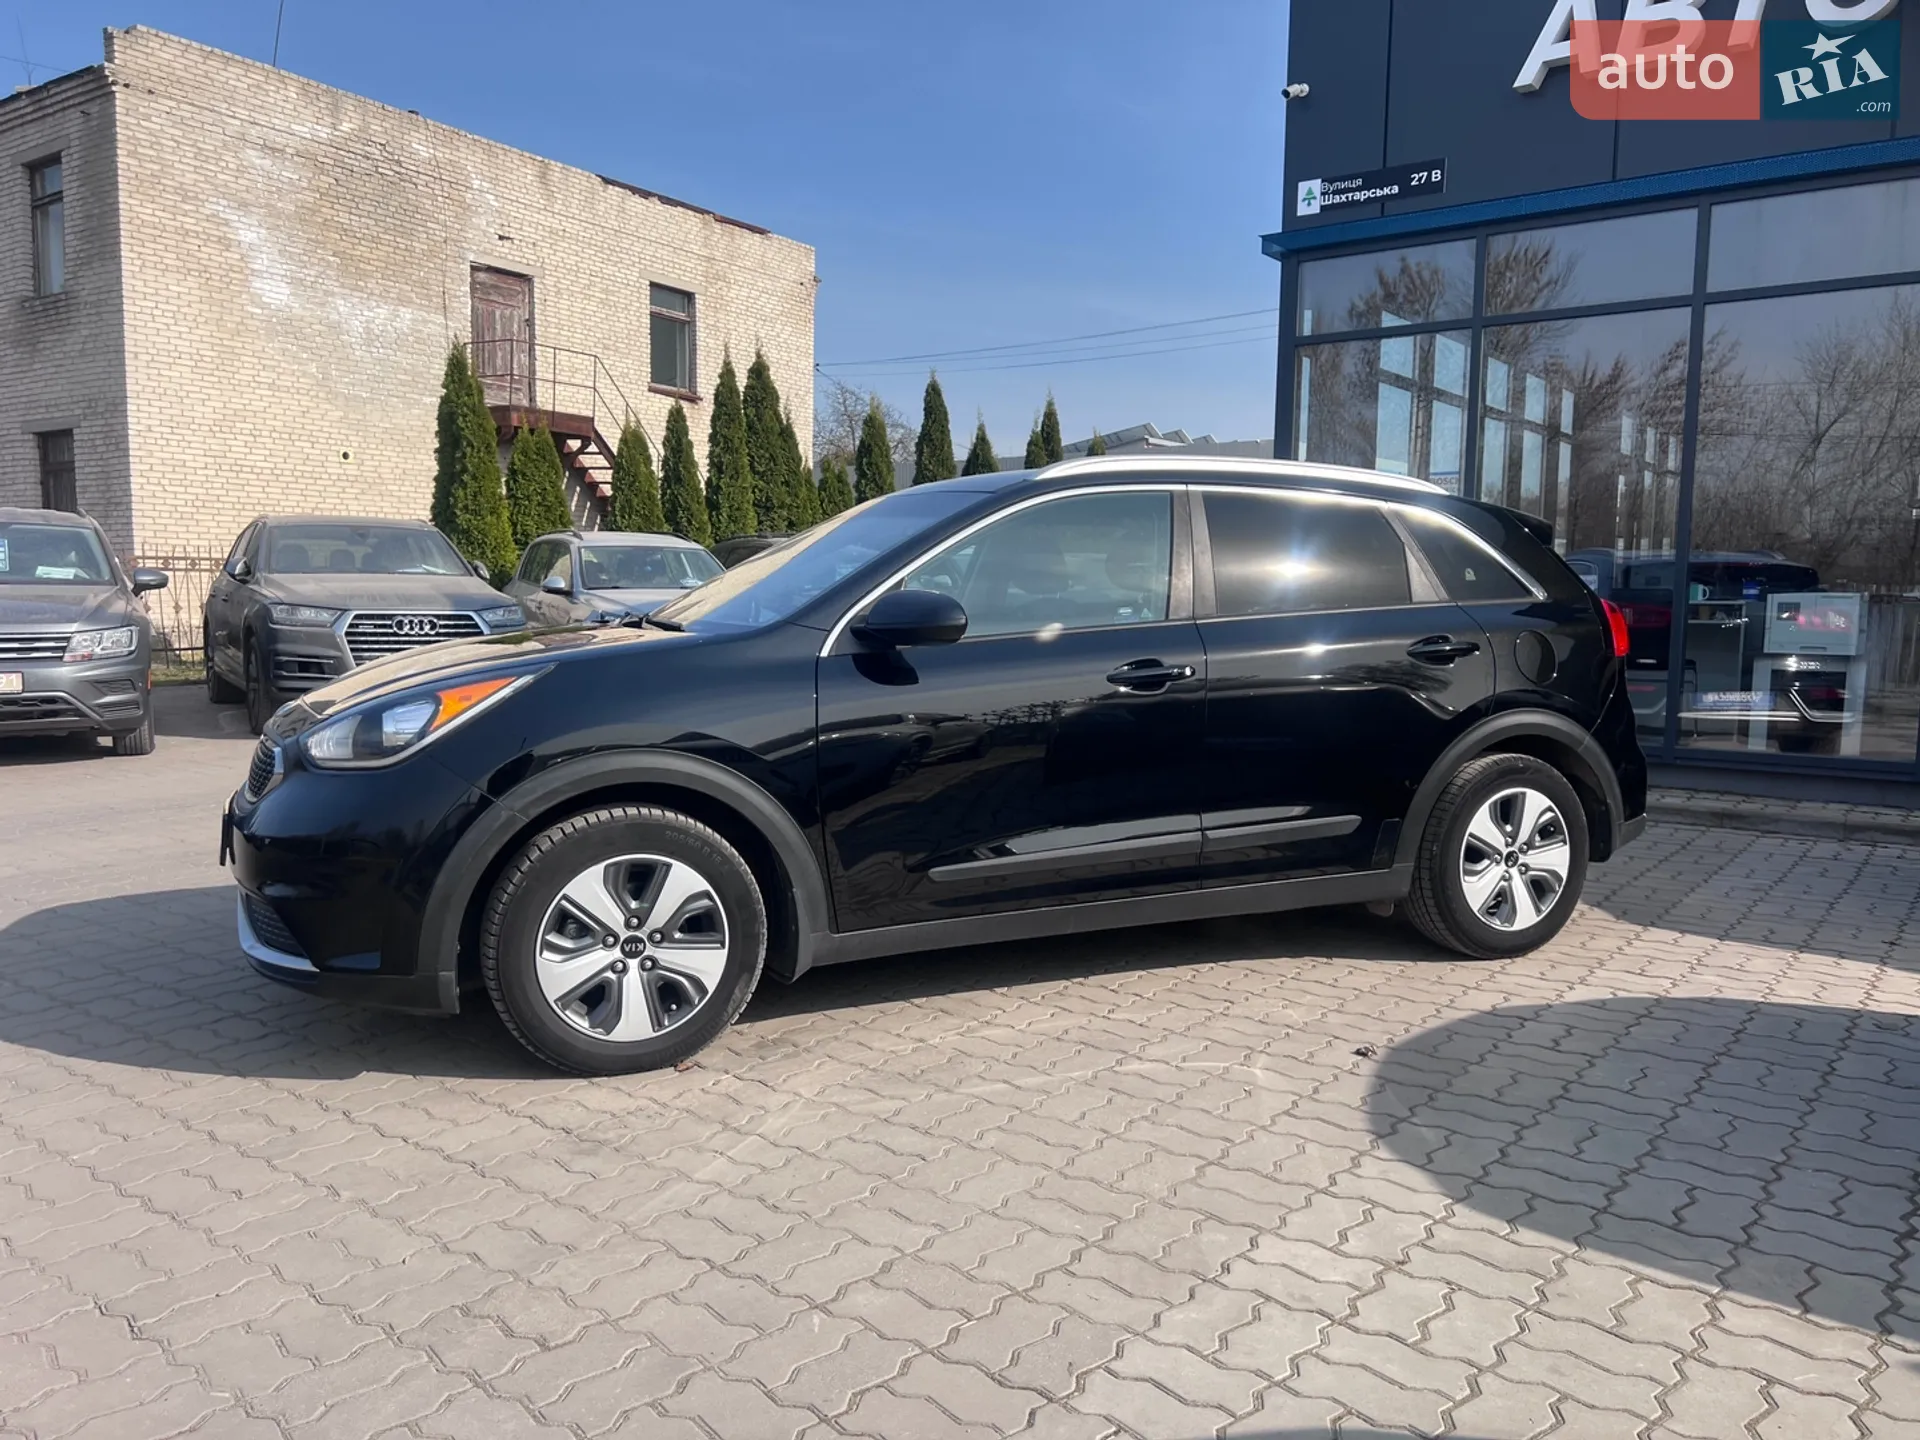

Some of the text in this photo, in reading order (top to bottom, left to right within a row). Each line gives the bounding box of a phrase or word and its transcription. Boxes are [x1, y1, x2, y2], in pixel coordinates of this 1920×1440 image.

[1512, 0, 1898, 94] АВ
[1321, 178, 1363, 194] Вулиця
[1410, 171, 1428, 186] 27
[1321, 184, 1399, 206] Шахтарська
[623, 942, 645, 952] KIA
